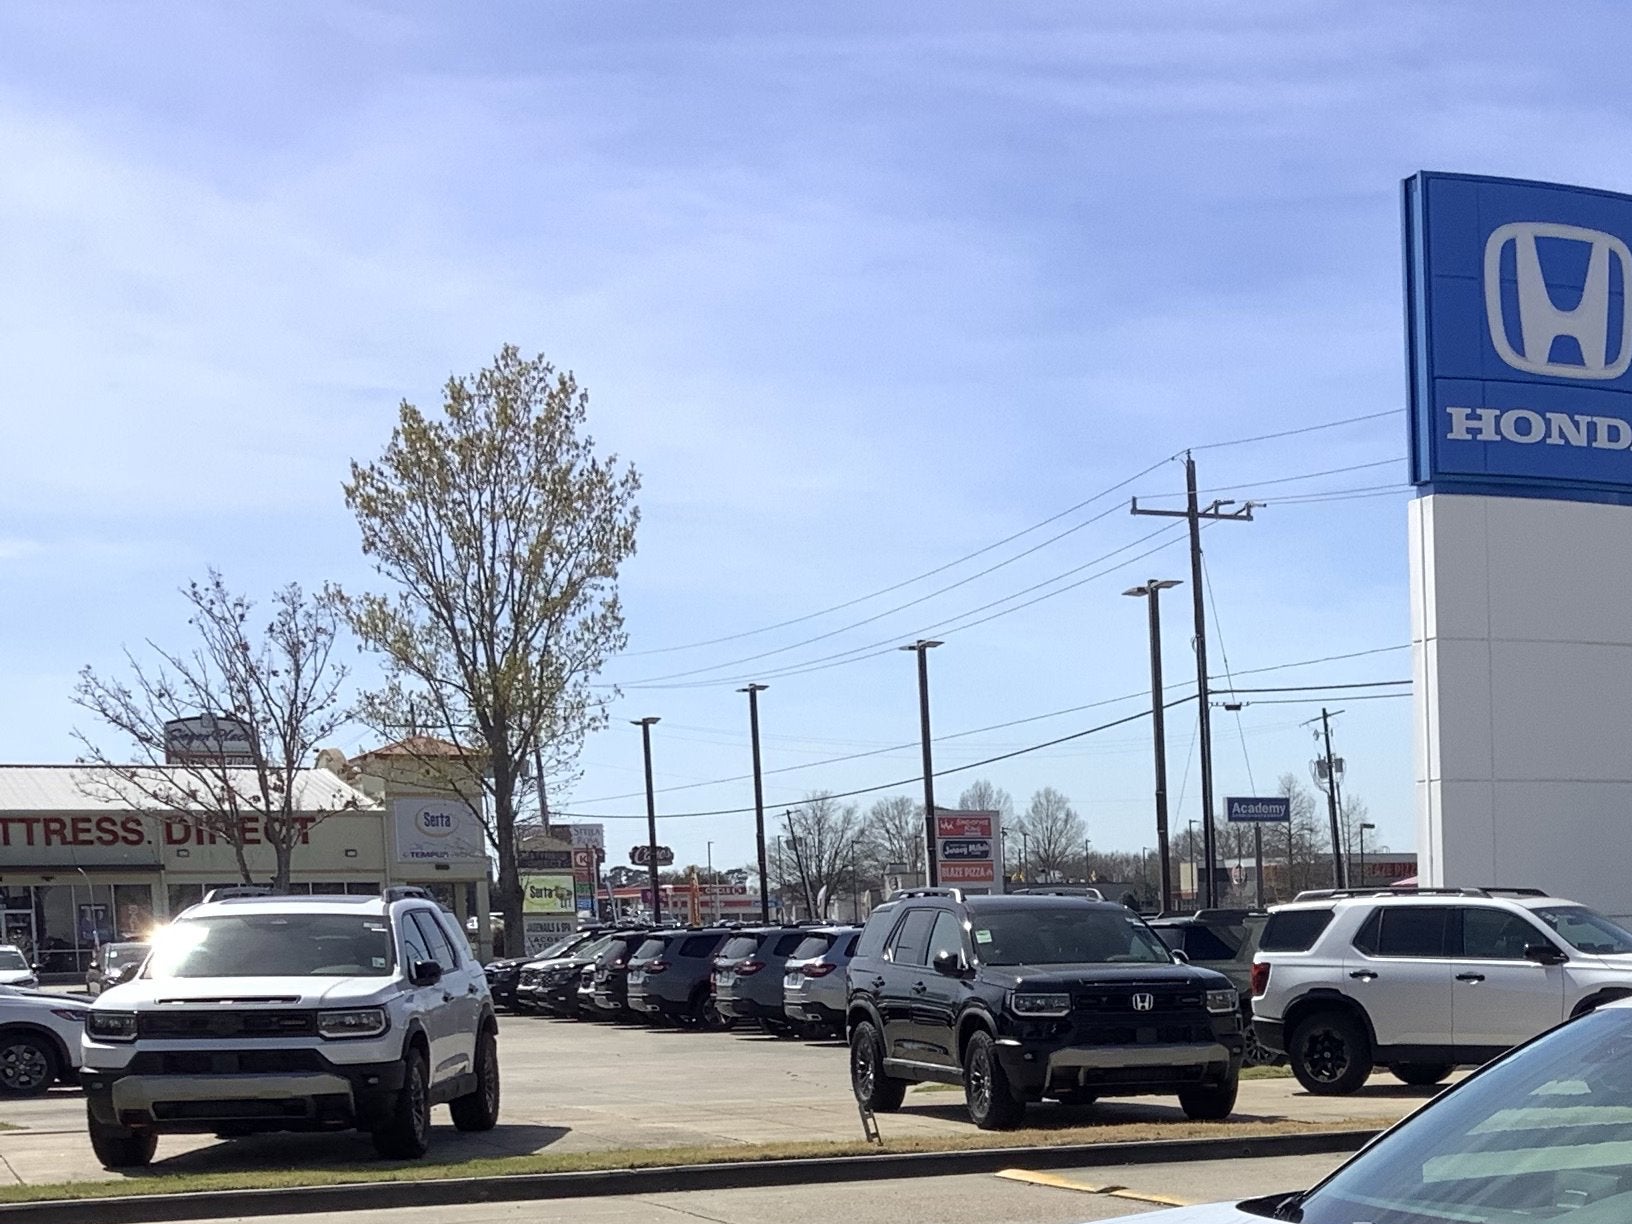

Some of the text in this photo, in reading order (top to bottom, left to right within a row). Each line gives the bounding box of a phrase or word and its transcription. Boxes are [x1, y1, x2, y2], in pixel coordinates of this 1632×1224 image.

[1231, 802, 1287, 817] Academy
[423, 811, 451, 827] Serta
[0, 815, 146, 846] TTRESS
[529, 885, 553, 899] Serta
